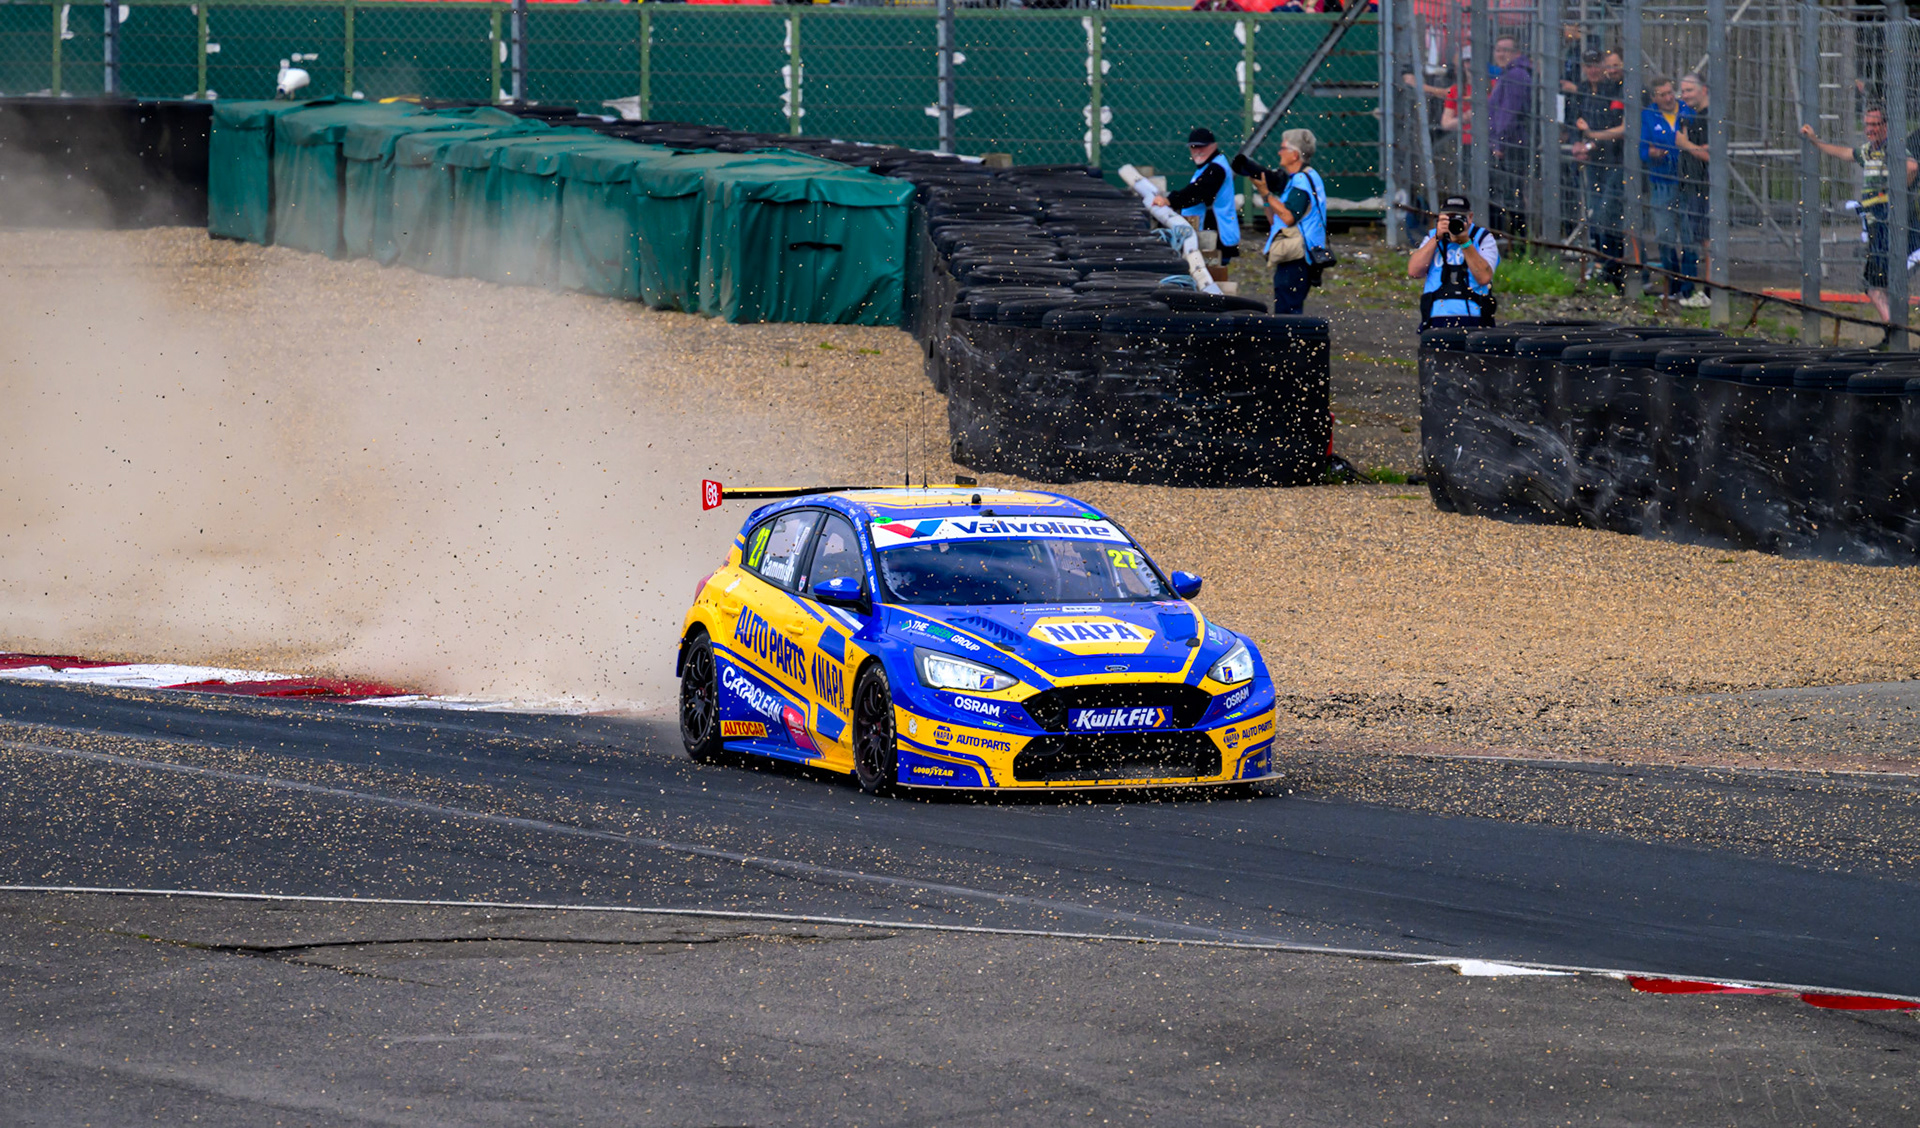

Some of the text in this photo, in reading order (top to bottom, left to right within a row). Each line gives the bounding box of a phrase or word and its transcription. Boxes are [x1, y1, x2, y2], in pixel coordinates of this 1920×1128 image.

[951, 521, 1111, 537] Valvoline
[748, 527, 771, 567] 27
[761, 554, 795, 583] Cammish
[1107, 549, 1137, 569] 27
[912, 621, 981, 651] THE GREEN GROUP
[1044, 623, 1142, 642] NAPA
[734, 605, 807, 685] AUTO PARTS
[722, 666, 783, 724] CATACLEAN
[817, 653, 849, 717] NAPA
[954, 696, 1001, 717] OSRAM
[1226, 686, 1249, 709] OSRAM
[723, 721, 766, 737] AUTOCAR
[935, 730, 951, 741] NAPA
[1242, 719, 1272, 739] AUTO PARTS
[956, 734, 1011, 753] AUTO PARTS
[913, 766, 954, 777] GOODYEAR
